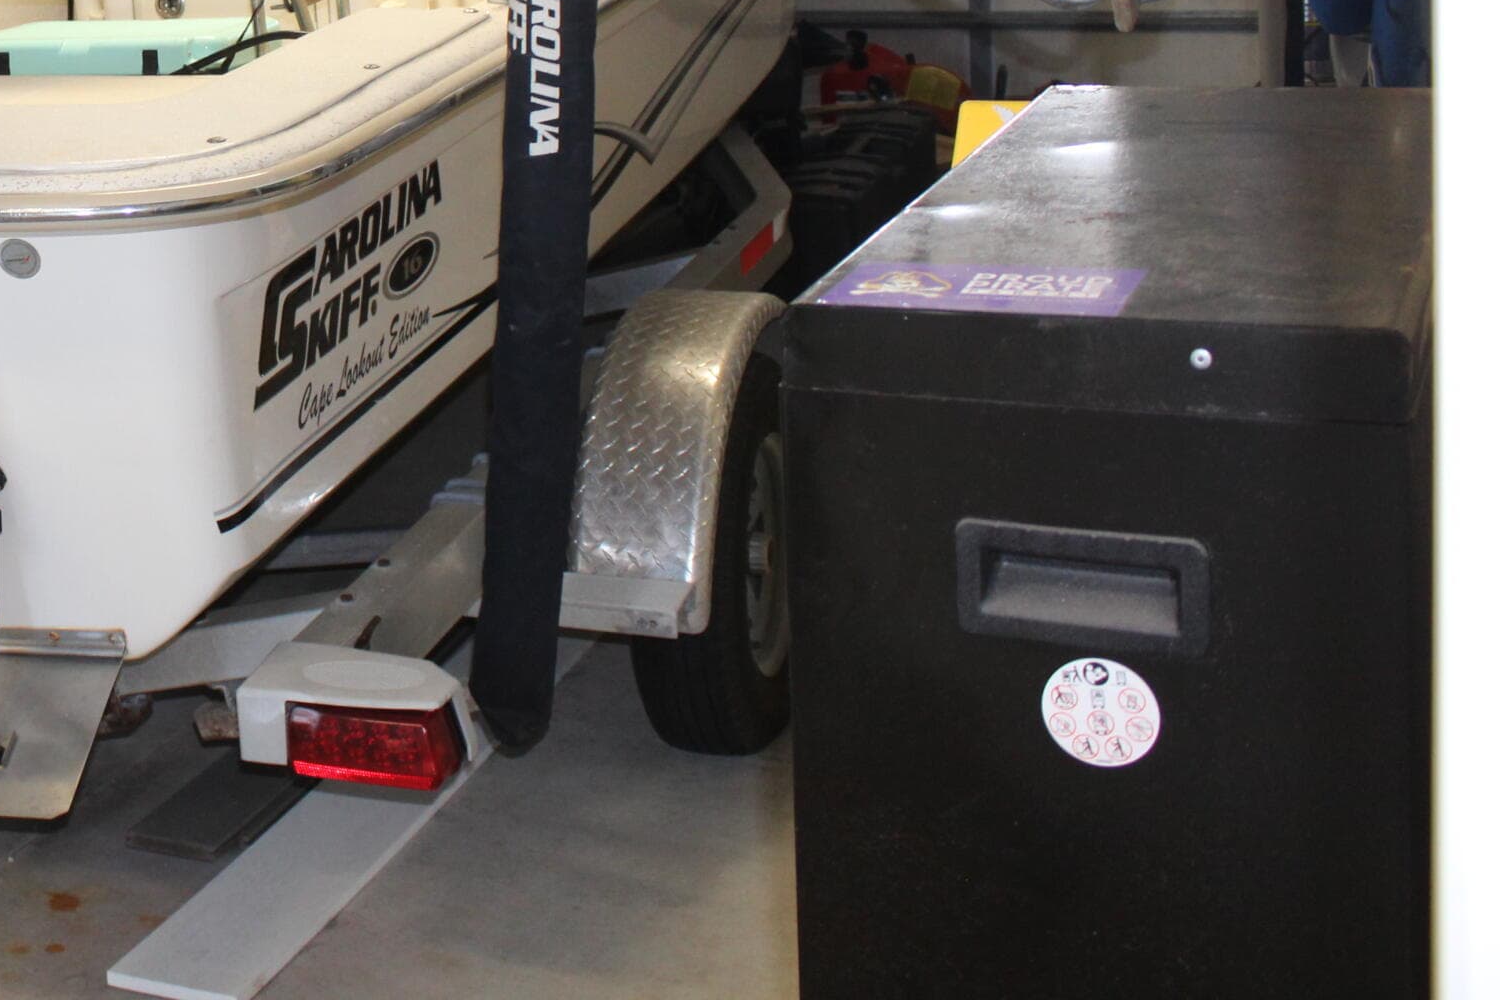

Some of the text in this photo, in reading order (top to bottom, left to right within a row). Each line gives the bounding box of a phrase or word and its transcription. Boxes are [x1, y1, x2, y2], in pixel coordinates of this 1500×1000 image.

[258, 158, 442, 378] CAROLINA
[403, 255, 423, 277] 16
[973, 272, 1114, 284] PROUD
[299, 305, 431, 430] Cape Lookout Edition
